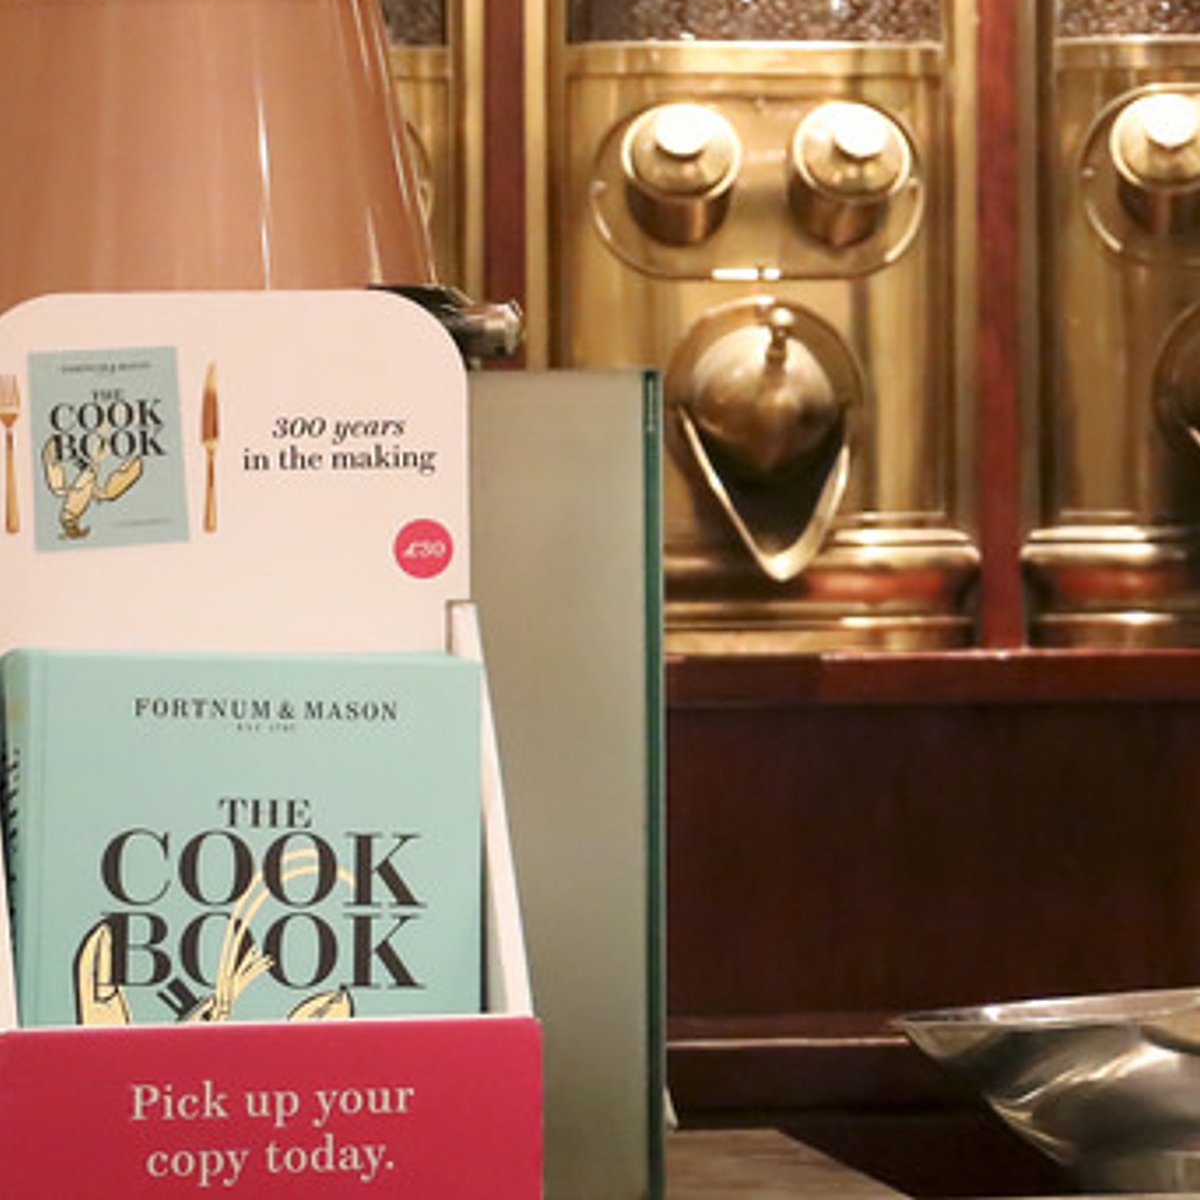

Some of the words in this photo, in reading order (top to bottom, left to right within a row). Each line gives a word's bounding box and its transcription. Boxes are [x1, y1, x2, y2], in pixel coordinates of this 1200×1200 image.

[50, 398, 164, 434] COOK
[272, 416, 327, 438] 300
[331, 419, 407, 445] years
[53, 429, 168, 462] BOOK
[243, 447, 270, 471] in
[278, 444, 324, 471] the
[331, 444, 438, 476] making
[134, 698, 272, 721] FORTNUM
[277, 700, 295, 721] &
[303, 700, 398, 722] MASON
[218, 797, 312, 829] THE
[100, 827, 427, 909] COOK
[98, 910, 427, 991] BOOK
[130, 1080, 230, 1121] Pick
[246, 1091, 301, 1127] up
[312, 1085, 416, 1127] your
[146, 1148, 251, 1187] copy
[265, 1133, 396, 1185] today.
